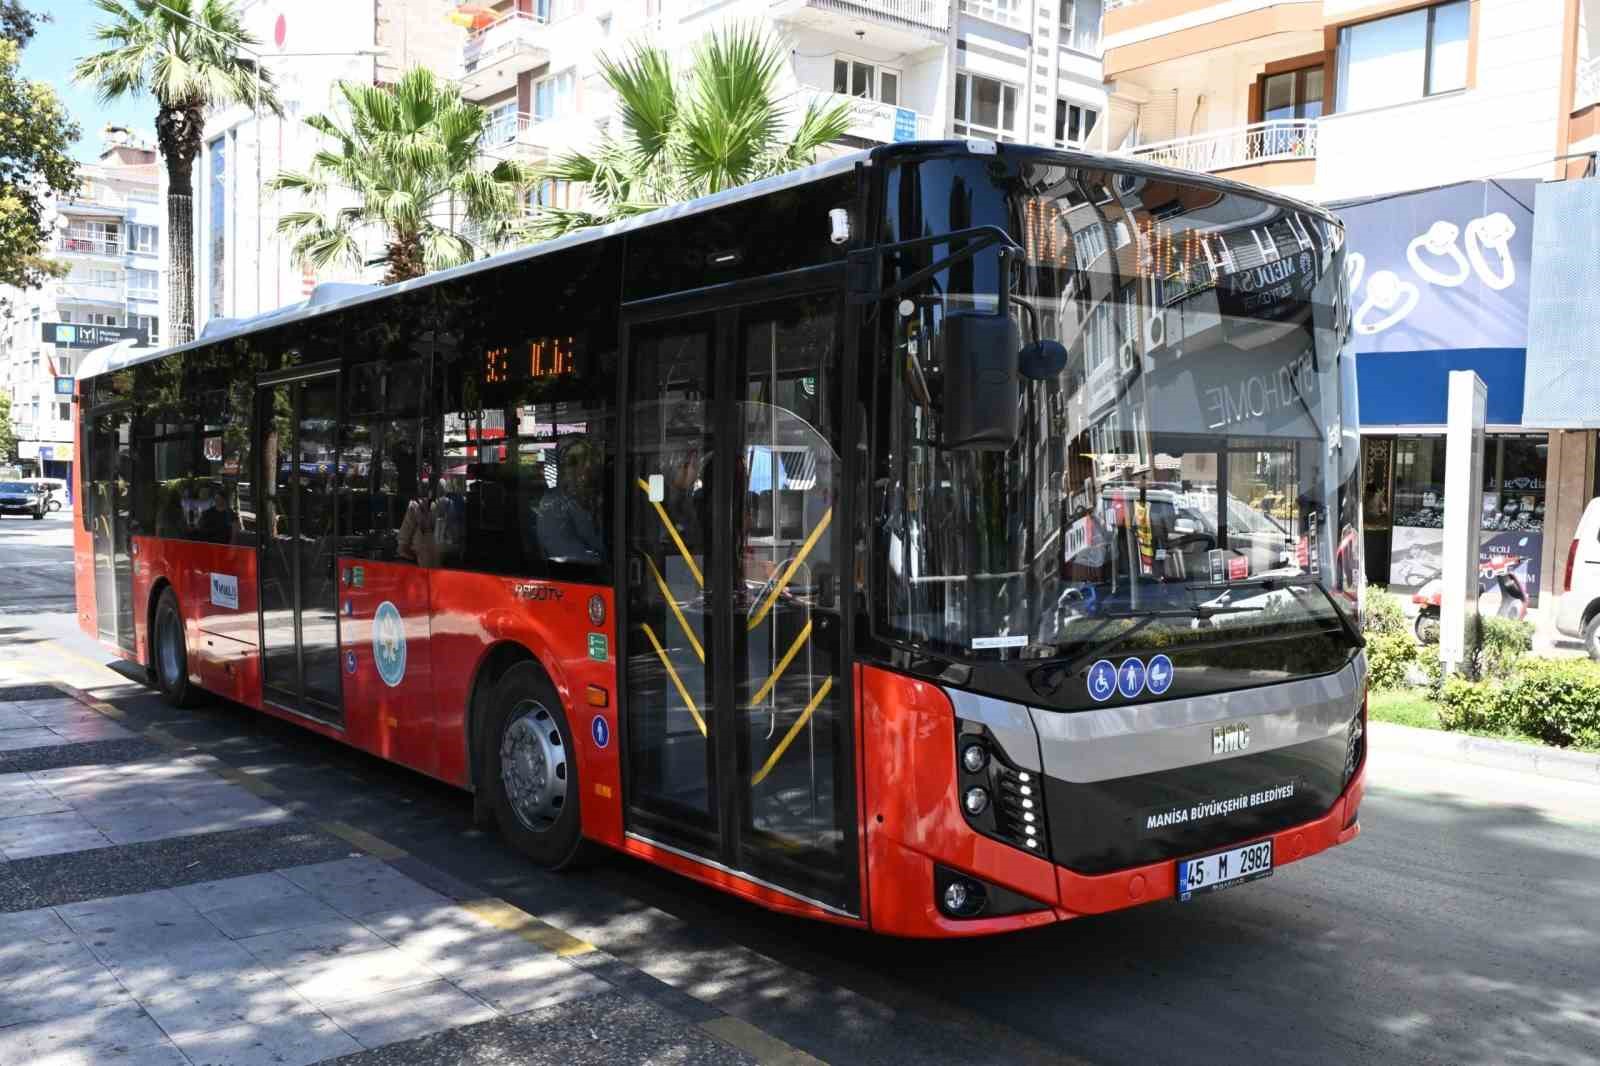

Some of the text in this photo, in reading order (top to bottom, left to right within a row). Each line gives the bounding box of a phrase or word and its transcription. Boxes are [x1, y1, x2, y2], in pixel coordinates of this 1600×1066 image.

[1212, 722, 1250, 755] BMC
[1147, 781, 1294, 829] MANİSA BÜYÜKŞEHİR BELEDİYESİ
[1188, 860, 1204, 887] 45
[1219, 854, 1228, 879] M
[1240, 844, 1270, 873] 2982
